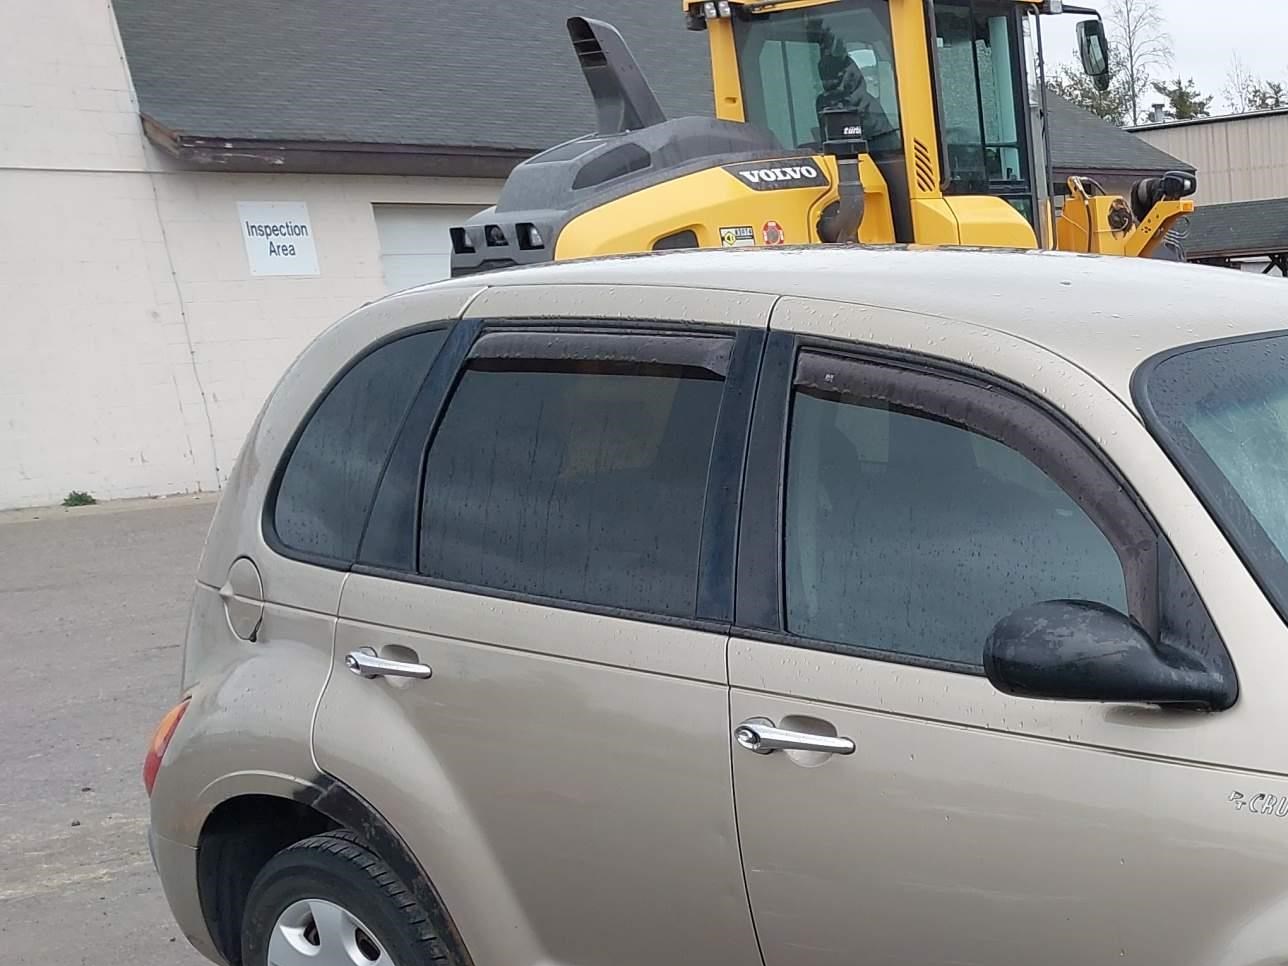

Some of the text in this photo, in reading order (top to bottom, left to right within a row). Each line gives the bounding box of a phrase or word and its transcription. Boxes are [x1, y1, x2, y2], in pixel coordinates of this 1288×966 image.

[739, 166, 818, 183] VOLVO
[245, 221, 308, 240] Inspection
[268, 241, 296, 256] Area
